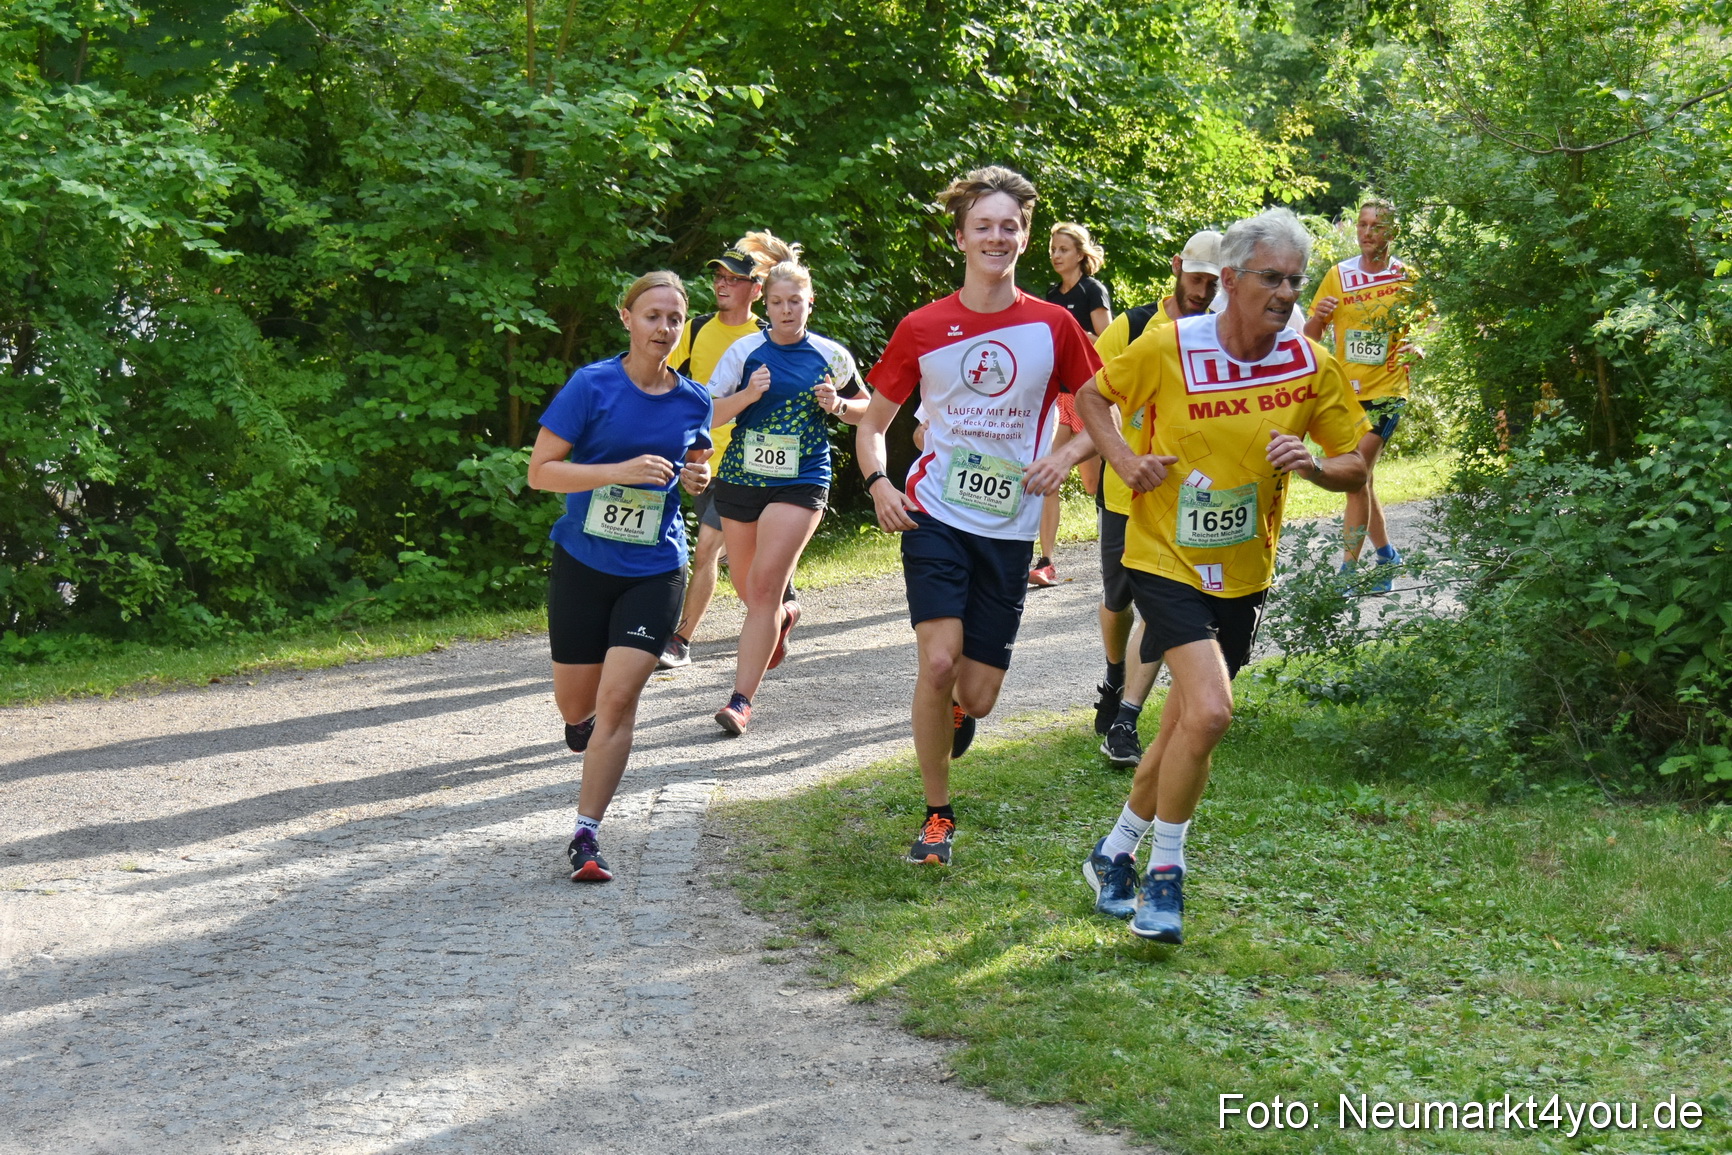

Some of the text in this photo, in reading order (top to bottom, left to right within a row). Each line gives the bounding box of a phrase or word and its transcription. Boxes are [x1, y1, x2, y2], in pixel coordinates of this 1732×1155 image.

[1350, 341, 1381, 356] 1663
[1188, 384, 1318, 420] MAX BÖGL
[947, 405, 983, 416] LAUFEN
[986, 408, 1004, 417] MIT
[952, 428, 1022, 440] Leistungsdiagnostik
[754, 447, 786, 465] 208
[957, 469, 1012, 499] 1905
[959, 490, 1003, 505] Spitzner Tilman
[603, 504, 645, 528] 871
[1188, 506, 1247, 531] 1659
[600, 522, 645, 535] Stepper Melanie
[1220, 528, 1243, 537] Michael
